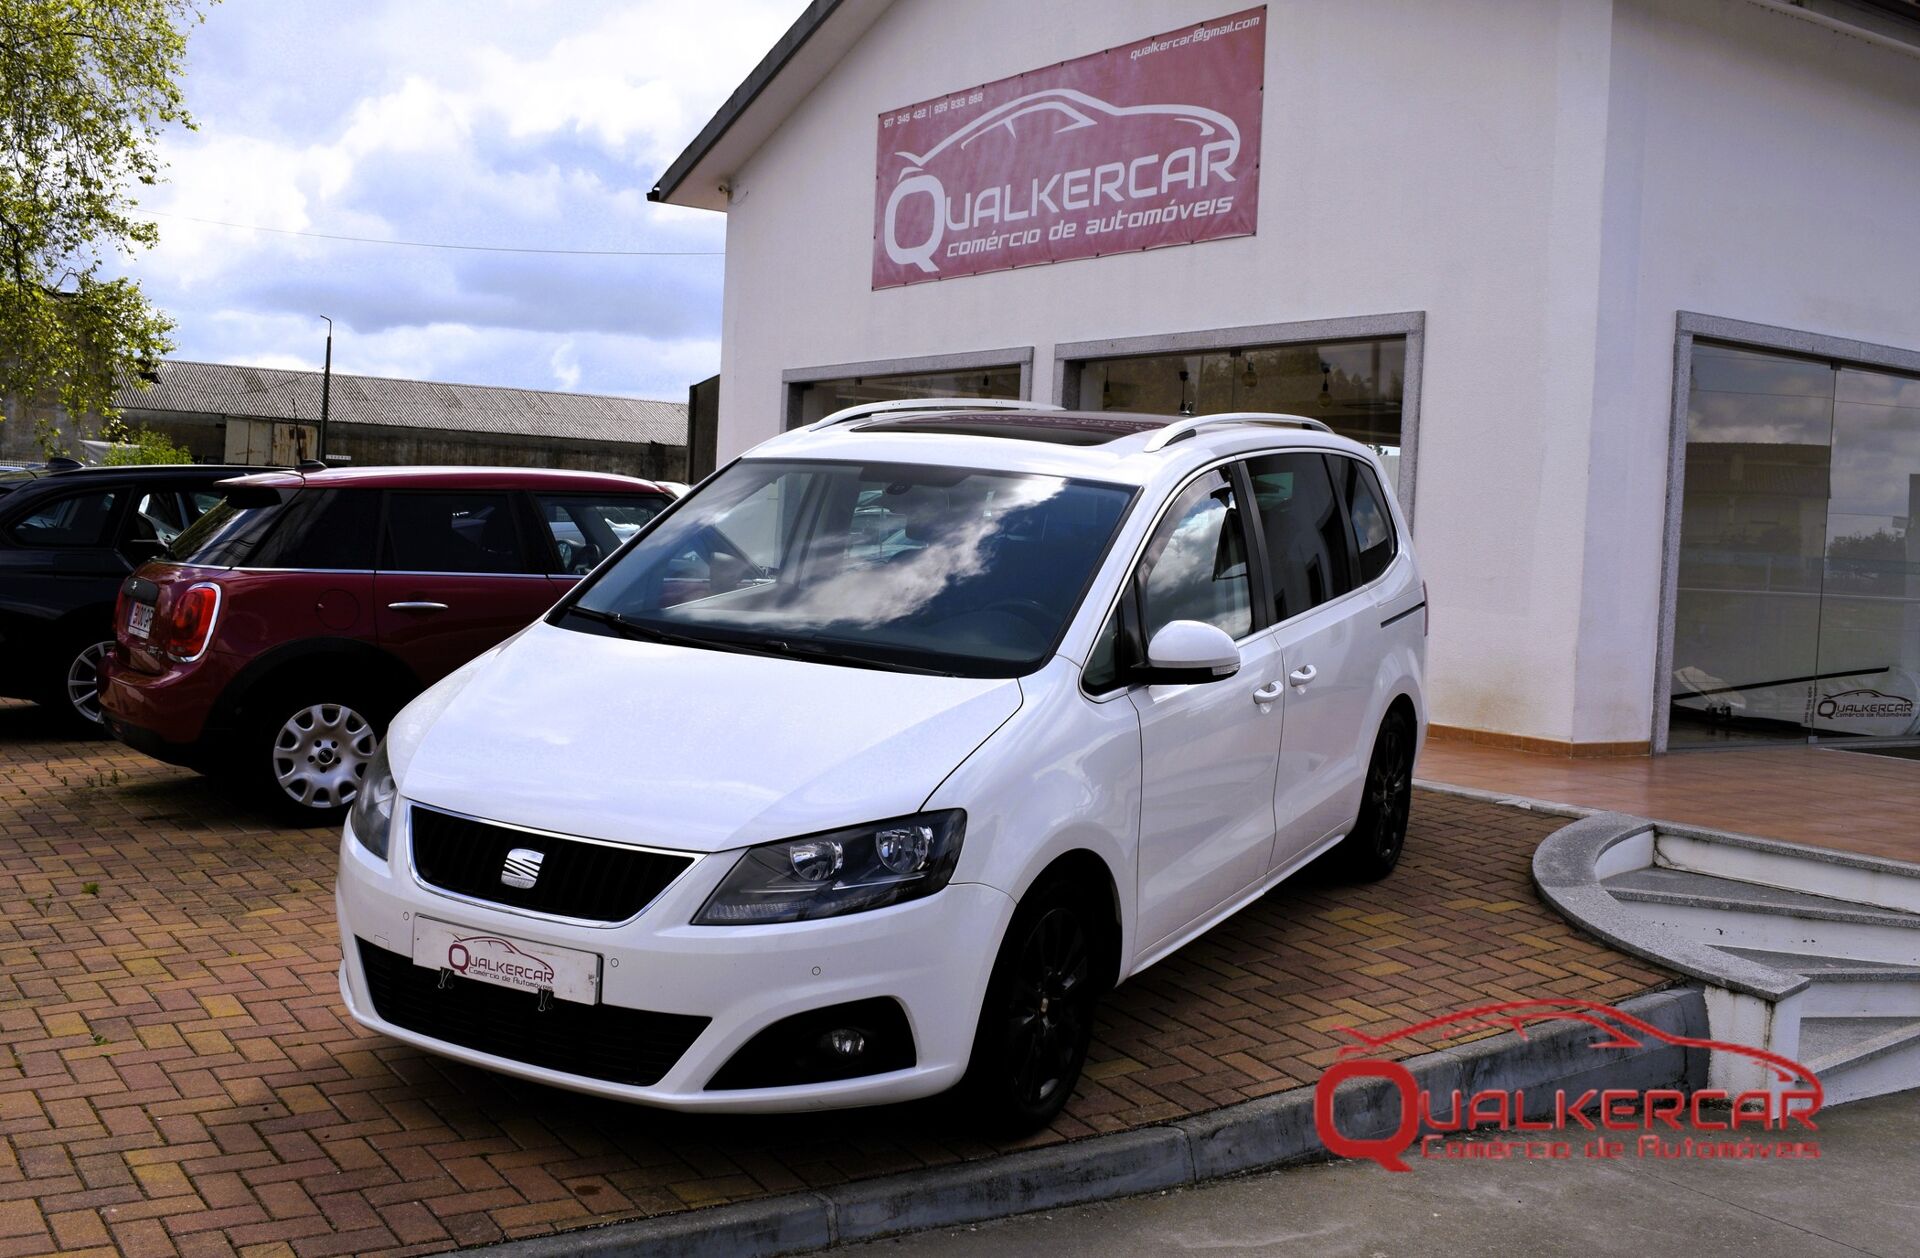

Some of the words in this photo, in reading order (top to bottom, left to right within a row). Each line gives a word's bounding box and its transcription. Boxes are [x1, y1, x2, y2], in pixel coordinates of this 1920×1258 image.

[1130, 16, 1260, 60] qualkercar@gmail.com
[884, 139, 1240, 272] QUALKERCAR
[946, 228, 1040, 257] comércio
[1048, 220, 1077, 241] de
[1085, 195, 1234, 235] automóveis
[1817, 700, 1913, 719] QUALKERCAR
[448, 943, 555, 984] QUALKERCAR
